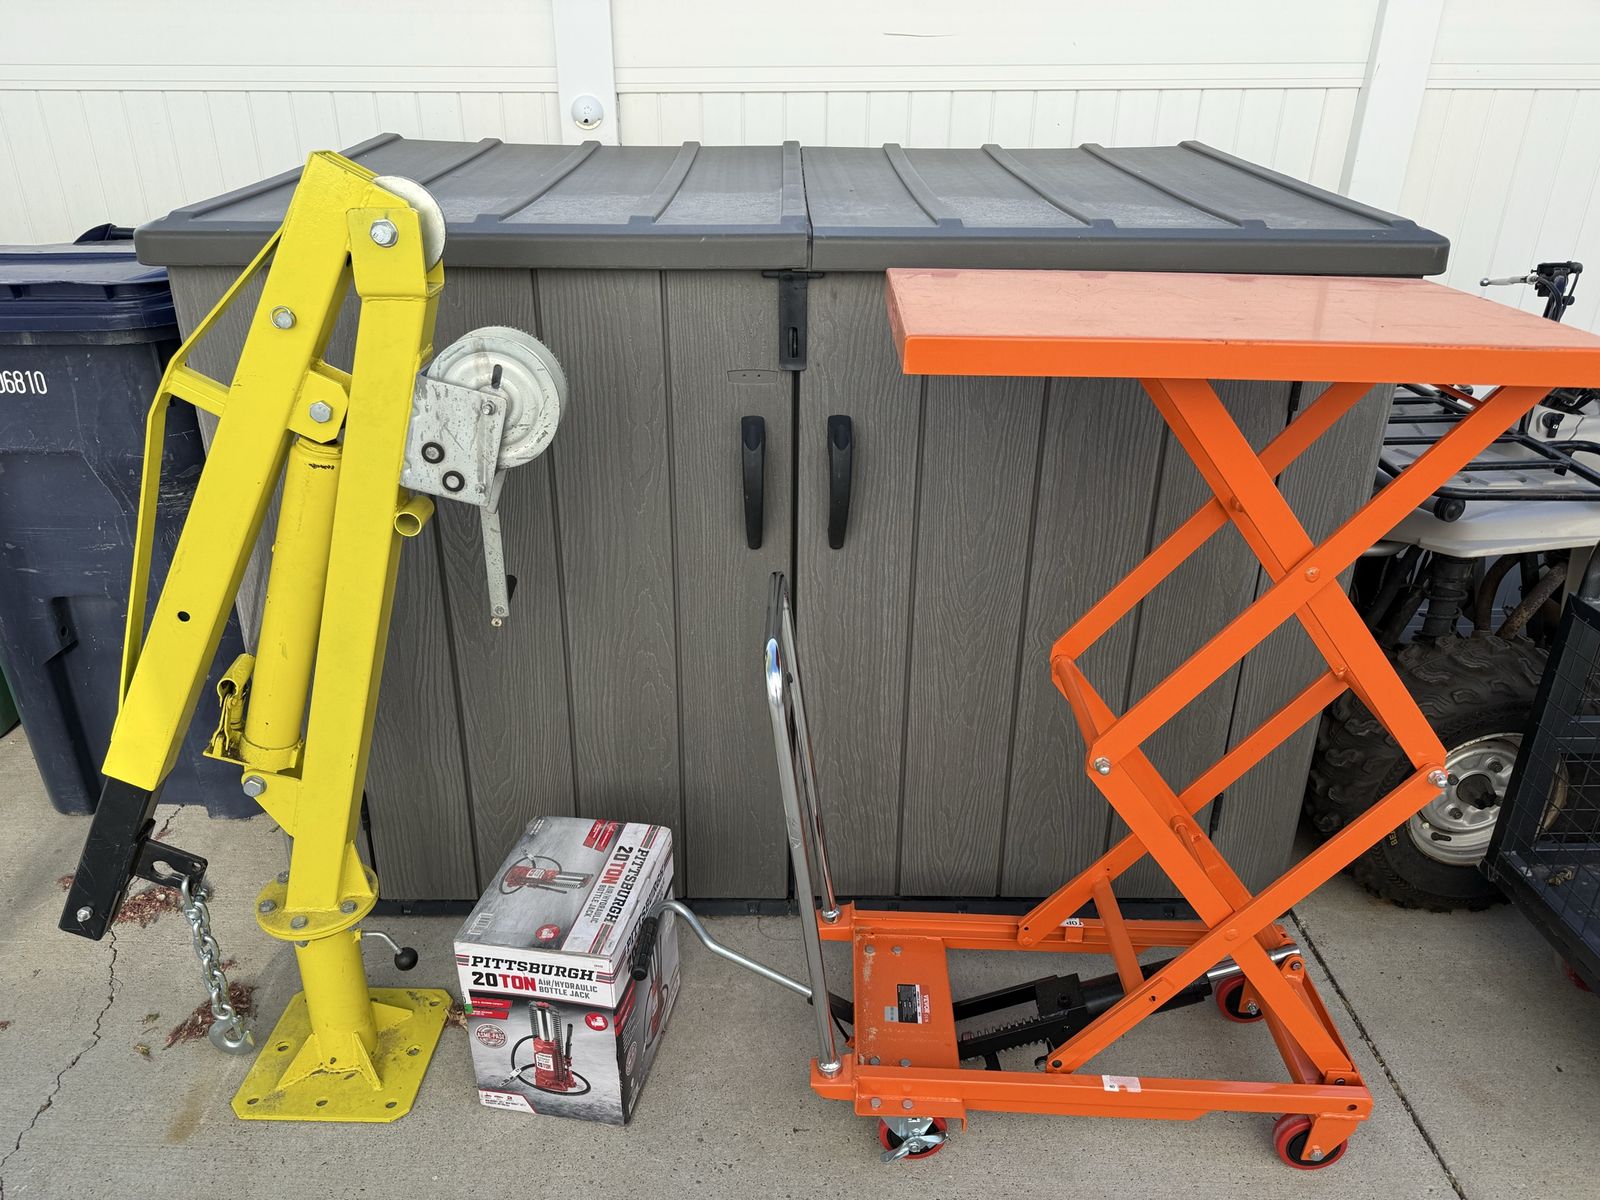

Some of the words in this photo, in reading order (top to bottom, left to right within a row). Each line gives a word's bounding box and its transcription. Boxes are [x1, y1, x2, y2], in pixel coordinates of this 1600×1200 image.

[604, 848, 650, 923] PITTSBURGH
[471, 955, 595, 981] PITTSBURGH
[538, 978, 598, 993] AIR/HYDRAULIC
[539, 986, 568, 996] BOTTLE
[569, 989, 591, 999] JACK
